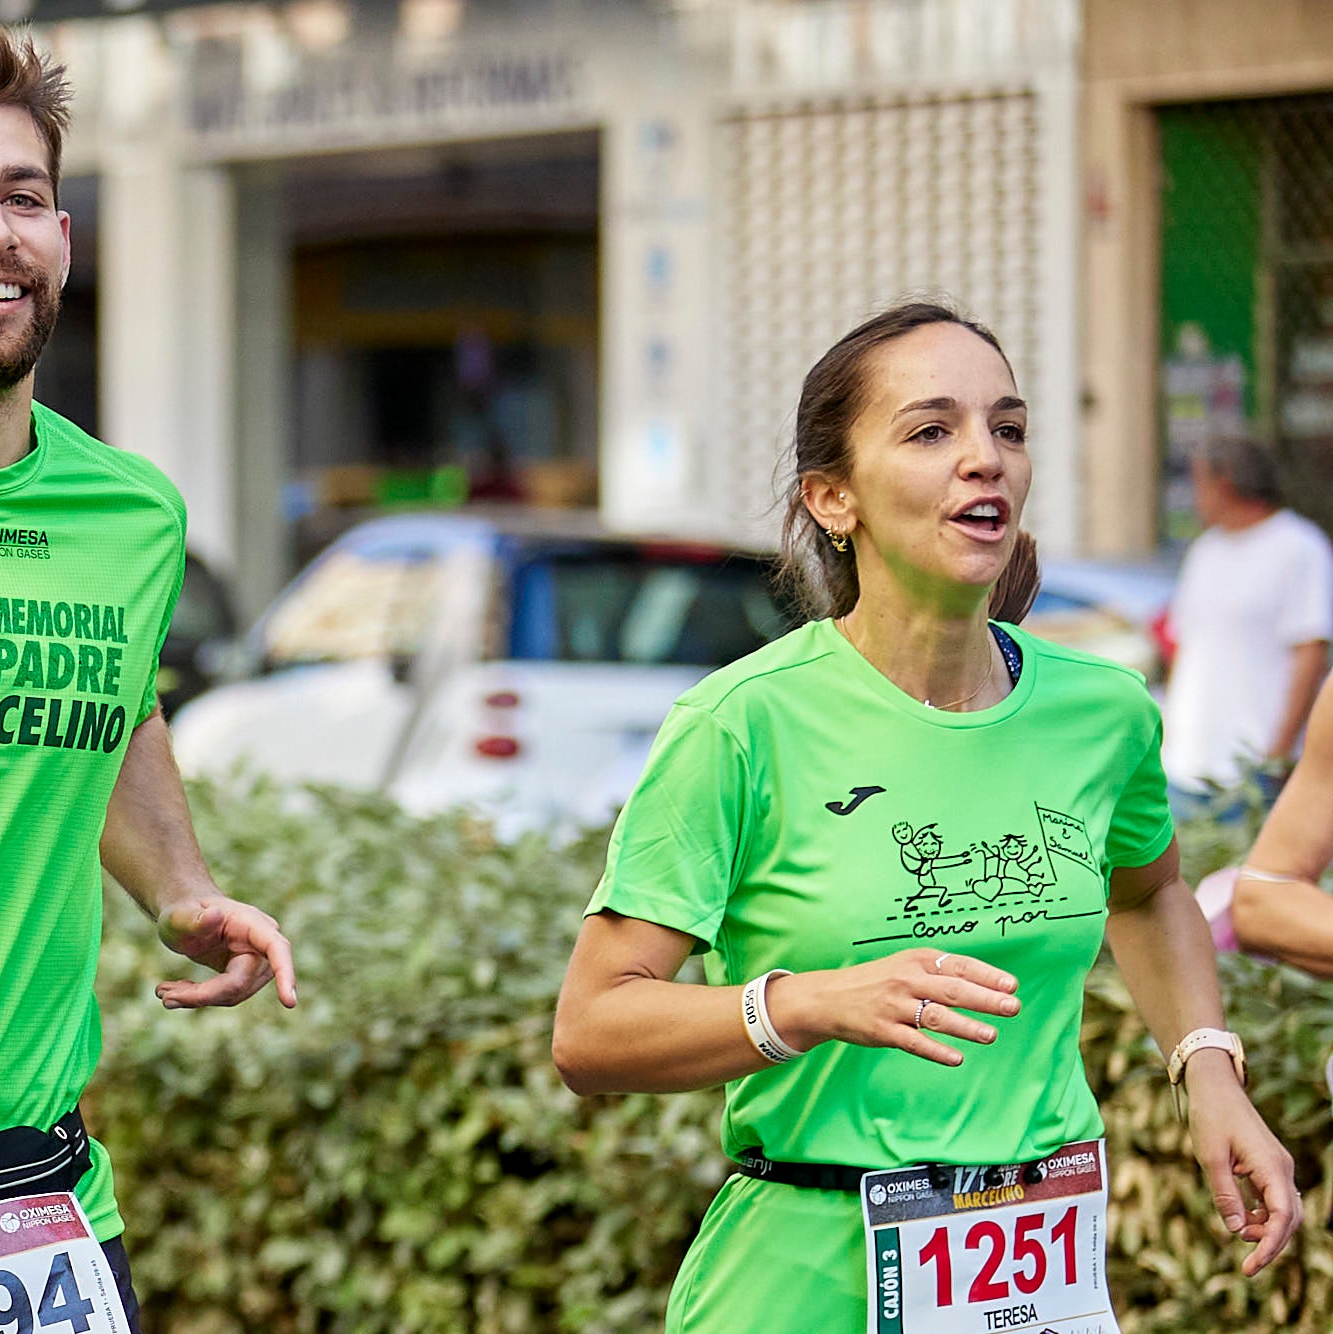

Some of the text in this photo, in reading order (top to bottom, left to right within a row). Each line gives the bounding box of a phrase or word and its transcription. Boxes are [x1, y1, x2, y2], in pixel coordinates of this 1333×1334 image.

[16, 546, 51, 560] GASES
[912, 921, 978, 938] Corro
[1047, 1151, 1096, 1169] OXIMESA
[953, 1166, 979, 1194] 17
[1049, 1164, 1097, 1179] NIPPON GASES
[887, 1178, 931, 1194] OXIMES
[887, 1193, 915, 1203] NIPPON
[952, 1184, 1025, 1210] MARCELINO
[19, 1203, 71, 1221] OXIMESA
[22, 1209, 75, 1230] NIPPON GASES
[918, 1205, 1078, 1308] 1251
[877, 1248, 899, 1319] CAJÓN 3
[983, 1302, 1038, 1331] TERESA
